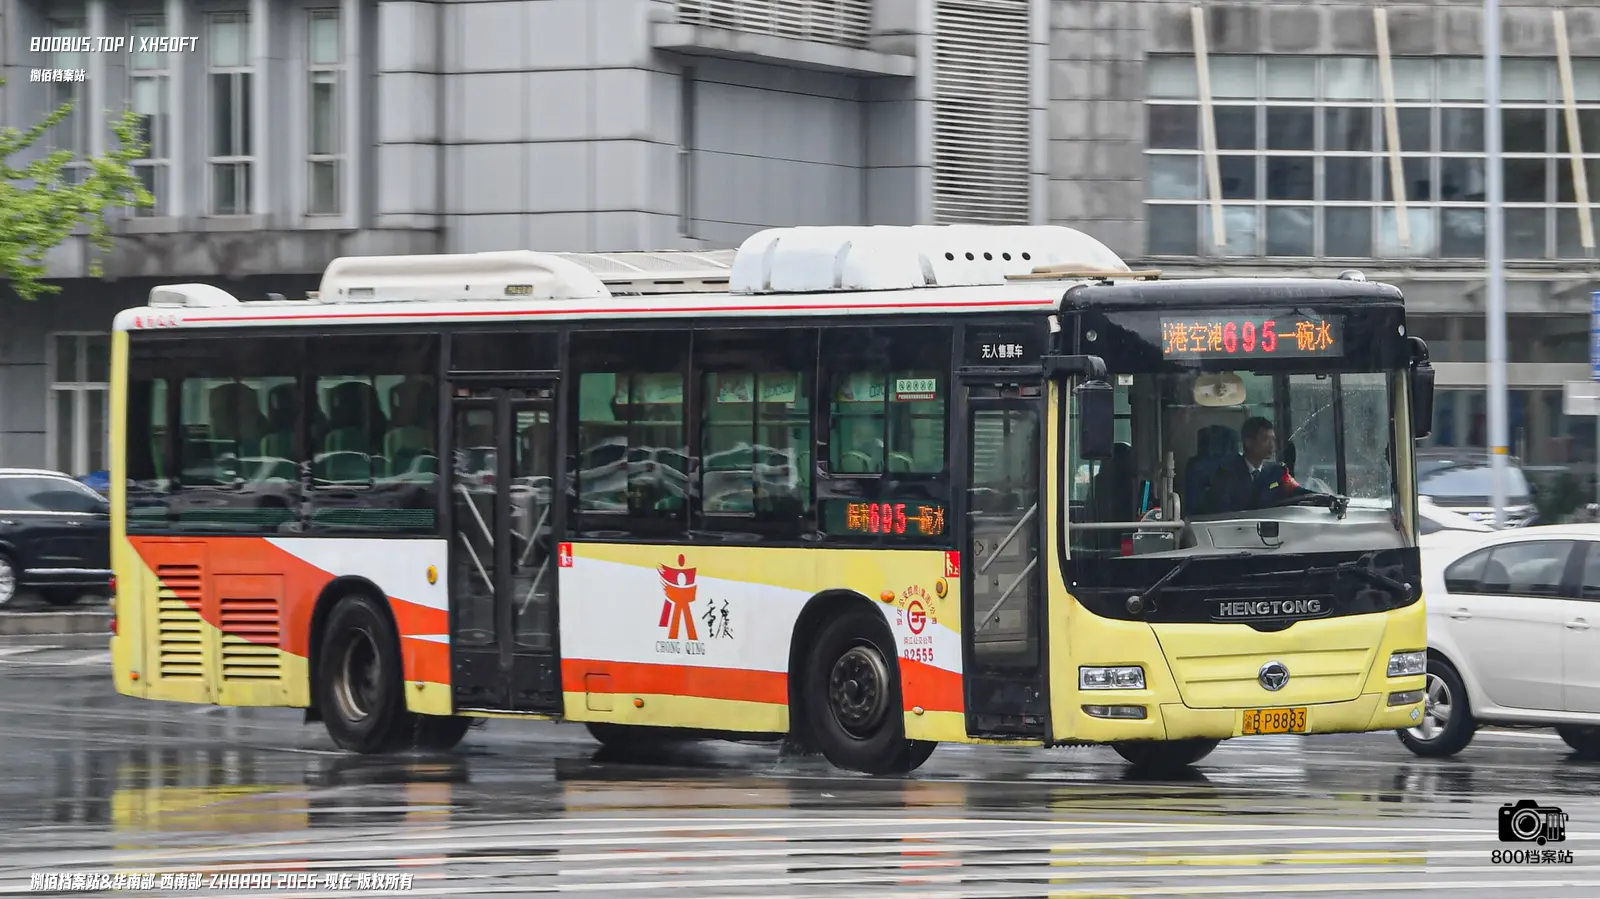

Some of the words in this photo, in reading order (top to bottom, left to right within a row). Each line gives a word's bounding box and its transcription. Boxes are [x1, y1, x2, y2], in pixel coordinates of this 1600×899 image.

[981, 343, 1024, 359] 无人售票车
[1219, 599, 1321, 616] HENGTONG
[655, 640, 681, 654] CHONG
[685, 641, 706, 656] QING
[903, 648, 934, 661] 82555
